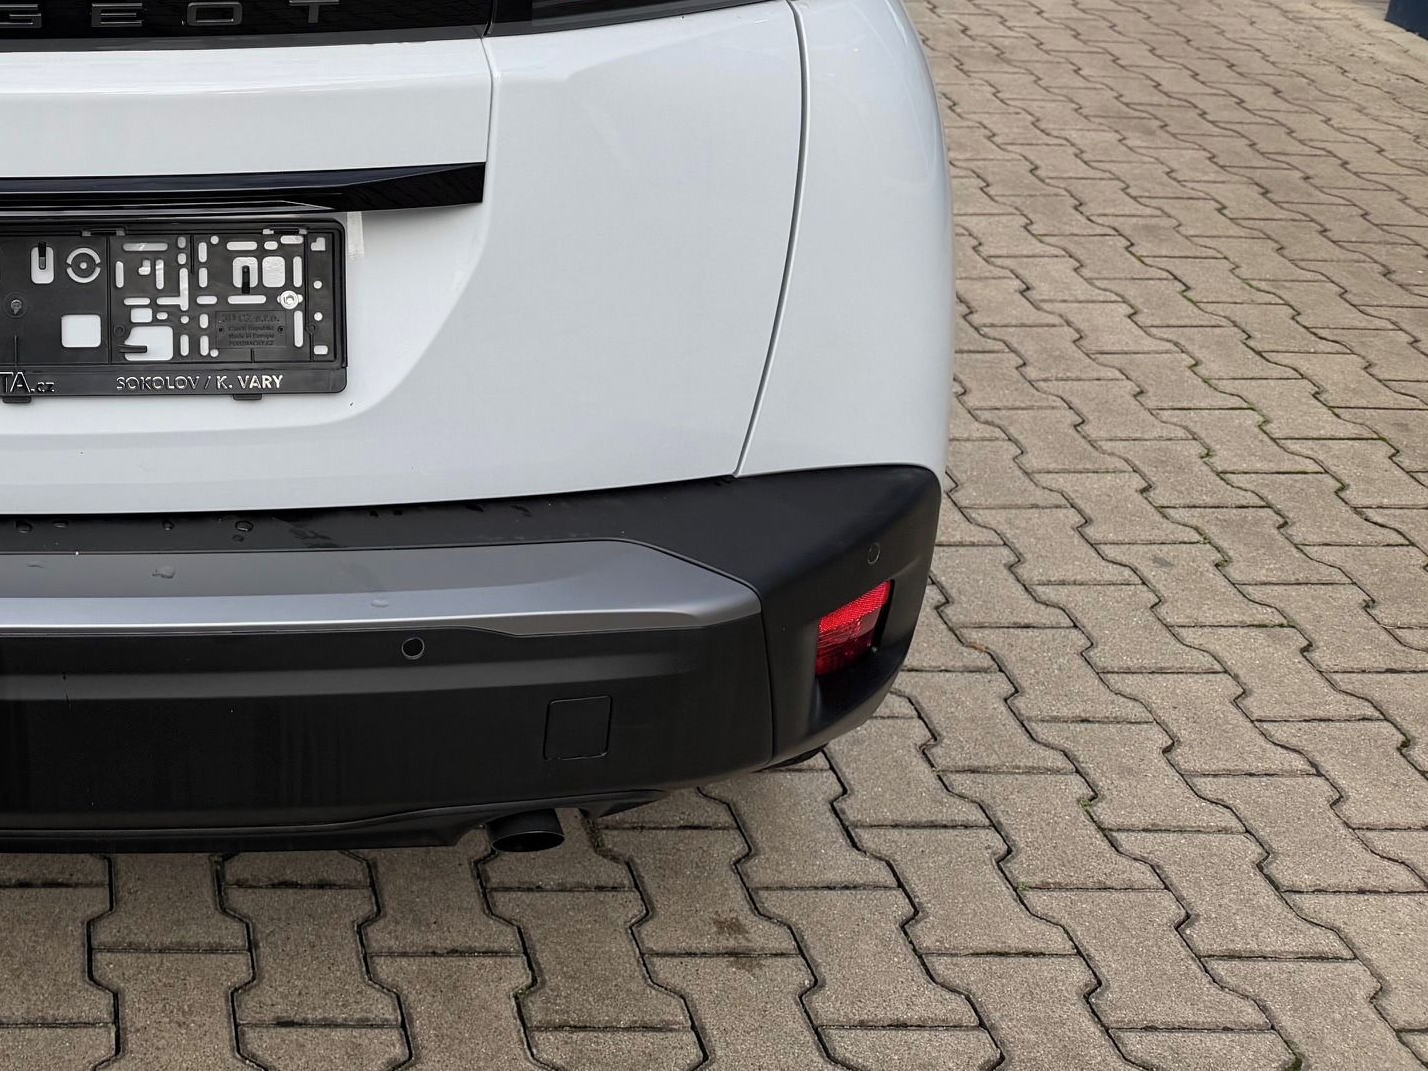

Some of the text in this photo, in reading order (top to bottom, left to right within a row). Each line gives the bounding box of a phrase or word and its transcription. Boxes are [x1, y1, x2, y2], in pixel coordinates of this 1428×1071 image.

[116, 376, 200, 390] SOKOLOV
[216, 375, 233, 390] K.
[237, 375, 283, 389] VARY
